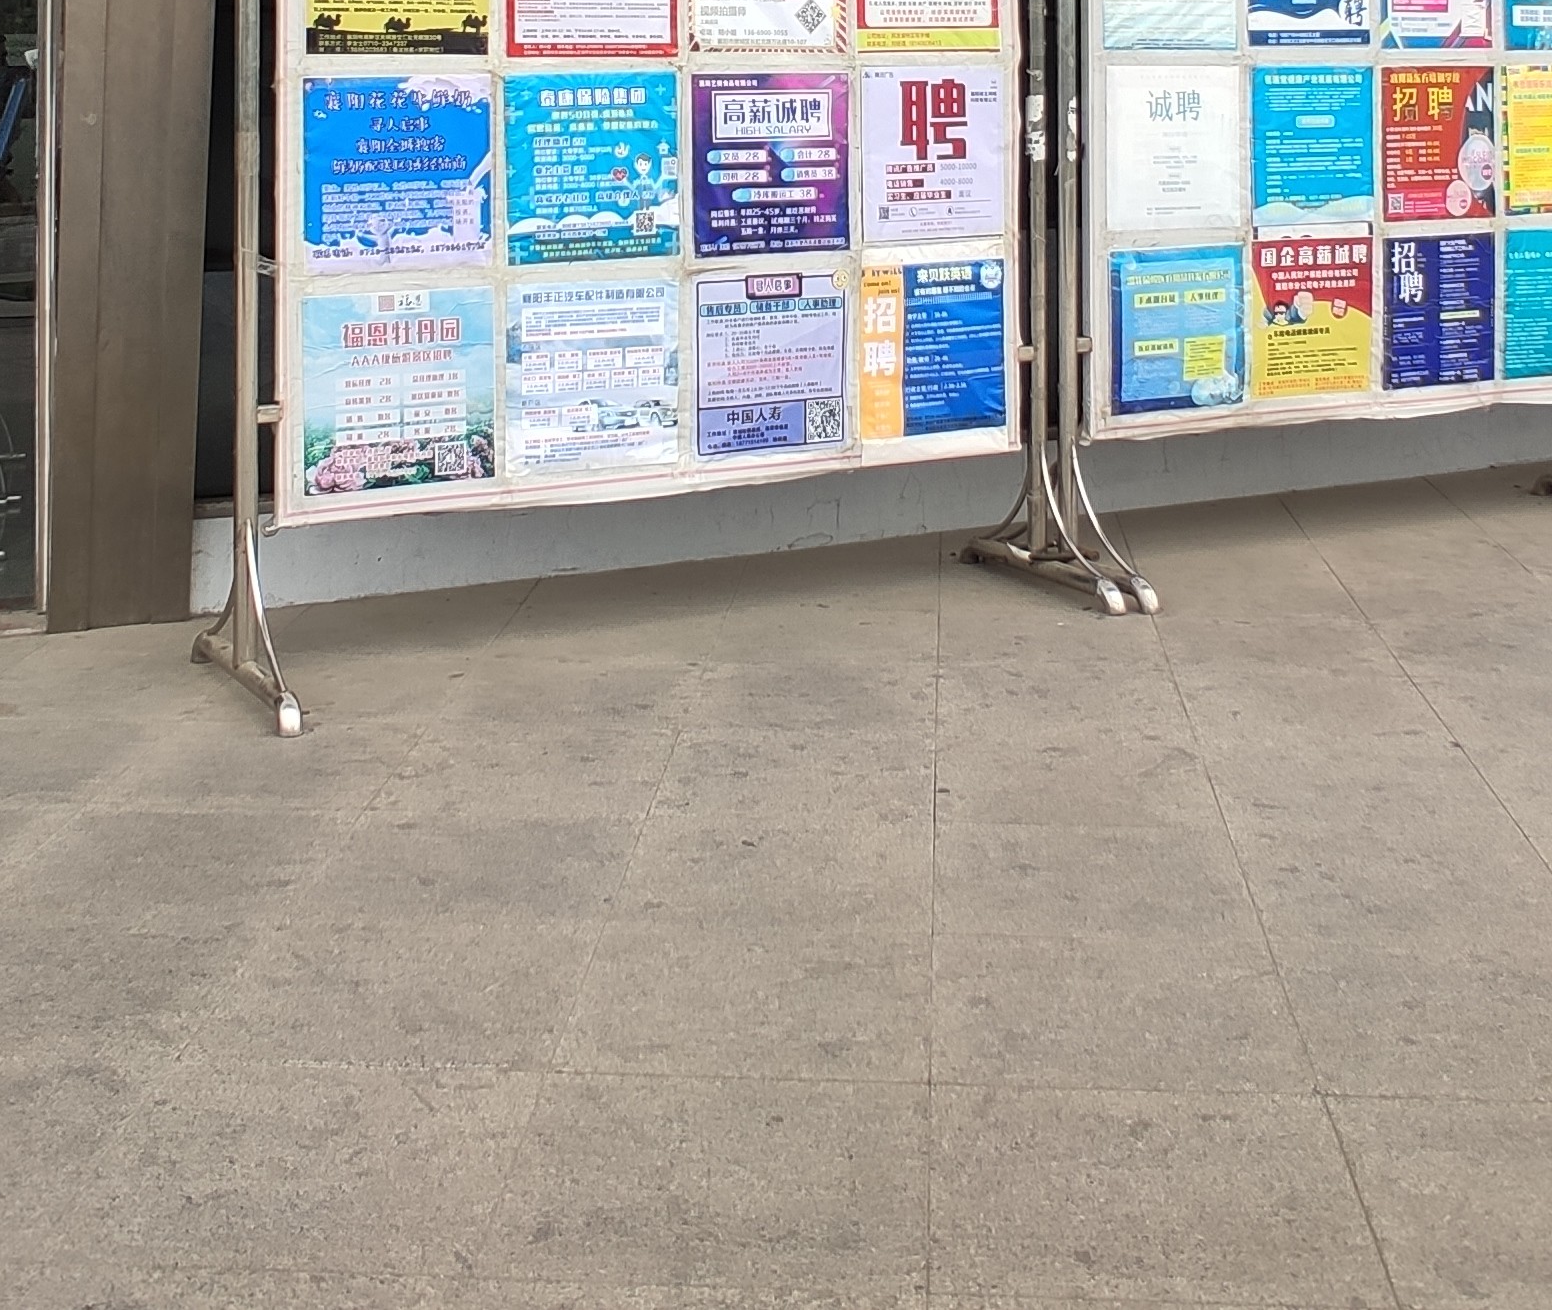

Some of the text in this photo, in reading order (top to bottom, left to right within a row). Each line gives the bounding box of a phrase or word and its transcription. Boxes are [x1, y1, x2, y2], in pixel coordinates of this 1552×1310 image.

[721, 98, 822, 125] 高薪诚聘
[1146, 89, 1202, 122] 诚聘
[1392, 86, 1454, 122] 招聘
[370, 116, 431, 133] 寻人启事
[735, 125, 812, 136] HIGH SALARY
[900, 78, 968, 161] 聘
[722, 152, 740, 161] 文员
[1260, 244, 1368, 268] 国企高薪诚聘
[755, 278, 793, 293] 寻人启事
[1391, 241, 1424, 303] 招聘
[341, 317, 461, 349] 福恩牡丹园
[863, 296, 898, 378] 招聘
[726, 405, 782, 426] 中国人寿
